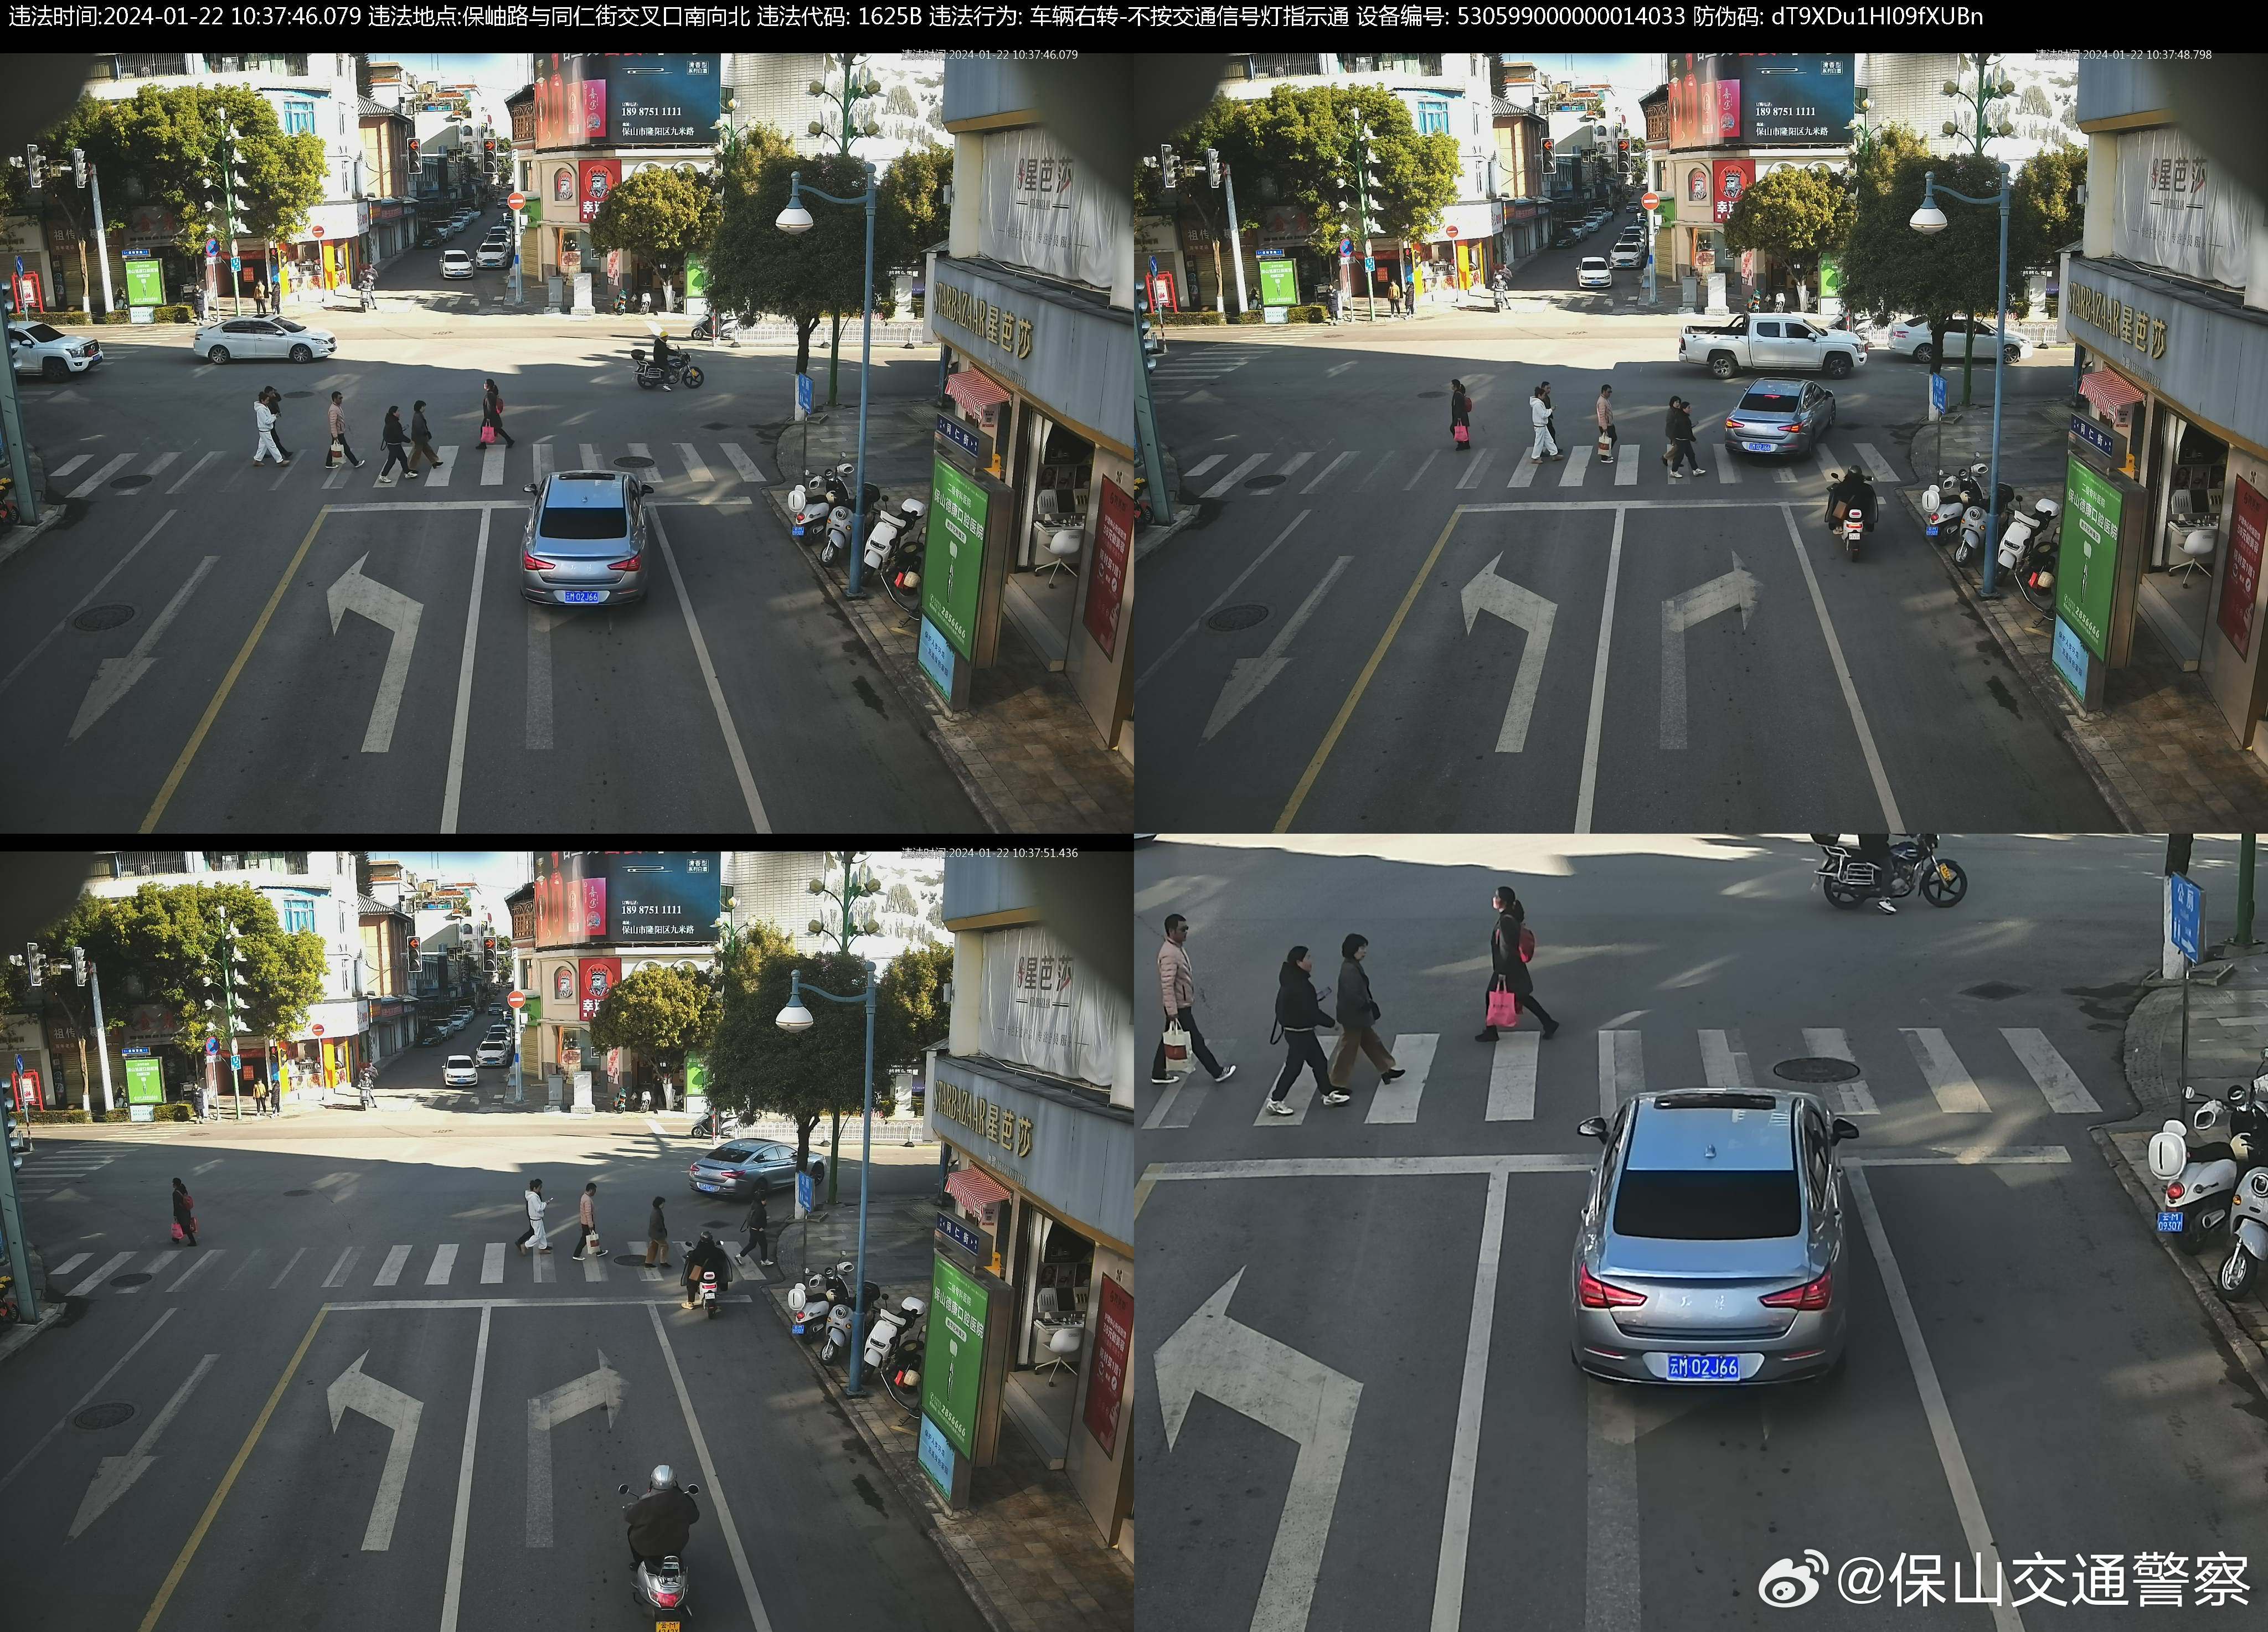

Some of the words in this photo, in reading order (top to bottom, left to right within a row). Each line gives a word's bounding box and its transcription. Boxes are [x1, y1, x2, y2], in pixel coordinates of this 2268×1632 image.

[622, 107, 637, 116] 189
[639, 107, 659, 116] 8751
[662, 107, 682, 116] 1111
[1756, 107, 1771, 116] 189
[1773, 107, 1793, 116] 8751
[1796, 107, 1816, 116] 1111
[622, 127, 695, 136] 保山市隆阳区九米路
[1756, 127, 1829, 136] 保山市隆阳区九米路
[1025, 157, 1073, 194] 星芭莎
[2159, 157, 2207, 194] 星芭莎
[934, 281, 987, 338] STARBAZAAR
[986, 304, 1034, 359] 星芭莎
[2068, 281, 2121, 338] STARBAZAAR
[2120, 304, 2168, 359] 星芭莎
[946, 423, 969, 446] 同仁街
[2080, 423, 2103, 446] 同仁街
[947, 483, 972, 508] 二级专科医院
[2081, 483, 2106, 508] 二级专科医院
[934, 488, 984, 541] 保山德康口腔医院
[2068, 488, 2118, 541] 保山德康口腔医院
[941, 606, 966, 639] 2856666
[2075, 606, 2100, 639] 2856666
[622, 905, 637, 915] 189
[639, 905, 659, 915] 8751
[662, 905, 682, 915] 1111
[2177, 883, 2194, 912] 公厕
[622, 925, 695, 934] 保山市隆阳区九米路
[1025, 955, 1073, 992] 星芭莎
[934, 1080, 987, 1137] STARBAZAAR
[986, 1103, 1034, 1157] 星芭莎
[946, 1221, 969, 1244] 同仁街
[2158, 1221, 2181, 1231] 09307
[947, 1281, 972, 1306] 二级专科医院
[934, 1286, 984, 1339] 保山德康口腔医院
[941, 1404, 966, 1437] 2856666
